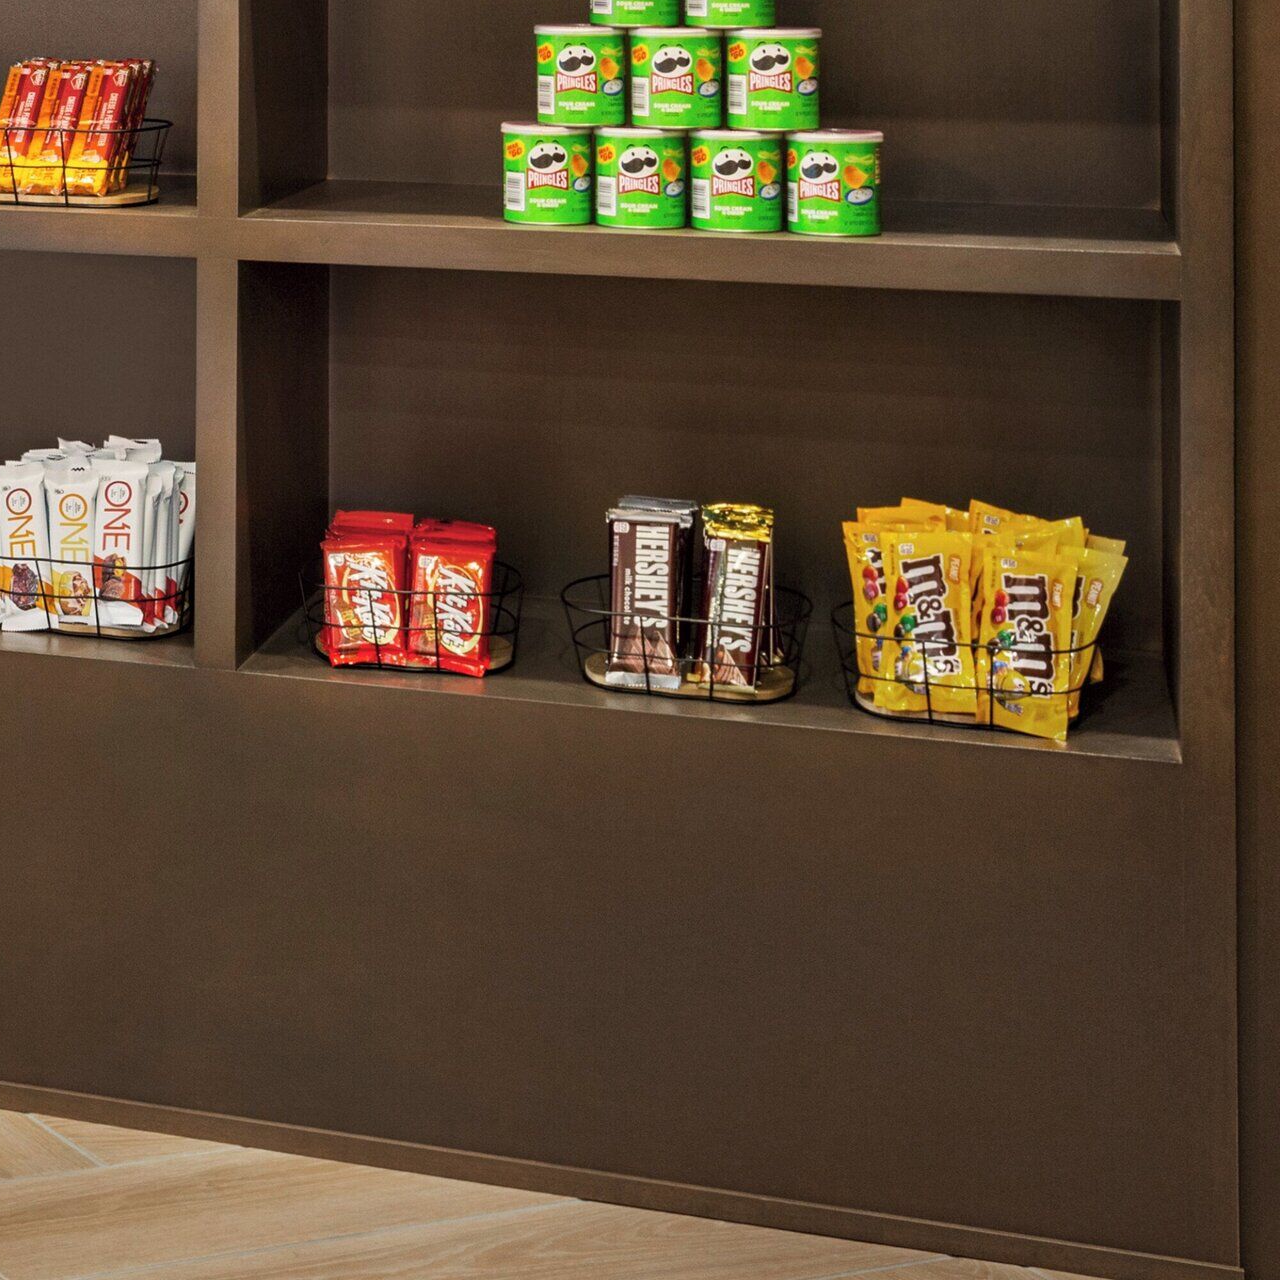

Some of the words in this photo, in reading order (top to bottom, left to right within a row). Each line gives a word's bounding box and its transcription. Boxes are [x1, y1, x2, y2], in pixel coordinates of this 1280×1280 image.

[556, 73, 596, 92] PRINGLES
[651, 74, 693, 93] PRINGLES
[749, 72, 791, 92] PRINGLES
[527, 171, 567, 189] PRINGLES
[618, 175, 659, 194] PRINGLES
[712, 177, 754, 196] PRINGLES
[799, 180, 840, 200] PRINGLES
[5, 487, 37, 558] ONE
[101, 480, 133, 552] ONE
[58, 493, 90, 566] ONE
[633, 524, 670, 629] HERSHEY'S
[718, 546, 761, 653] HERSHEY'S
[1087, 580, 1103, 606] PEANUT
